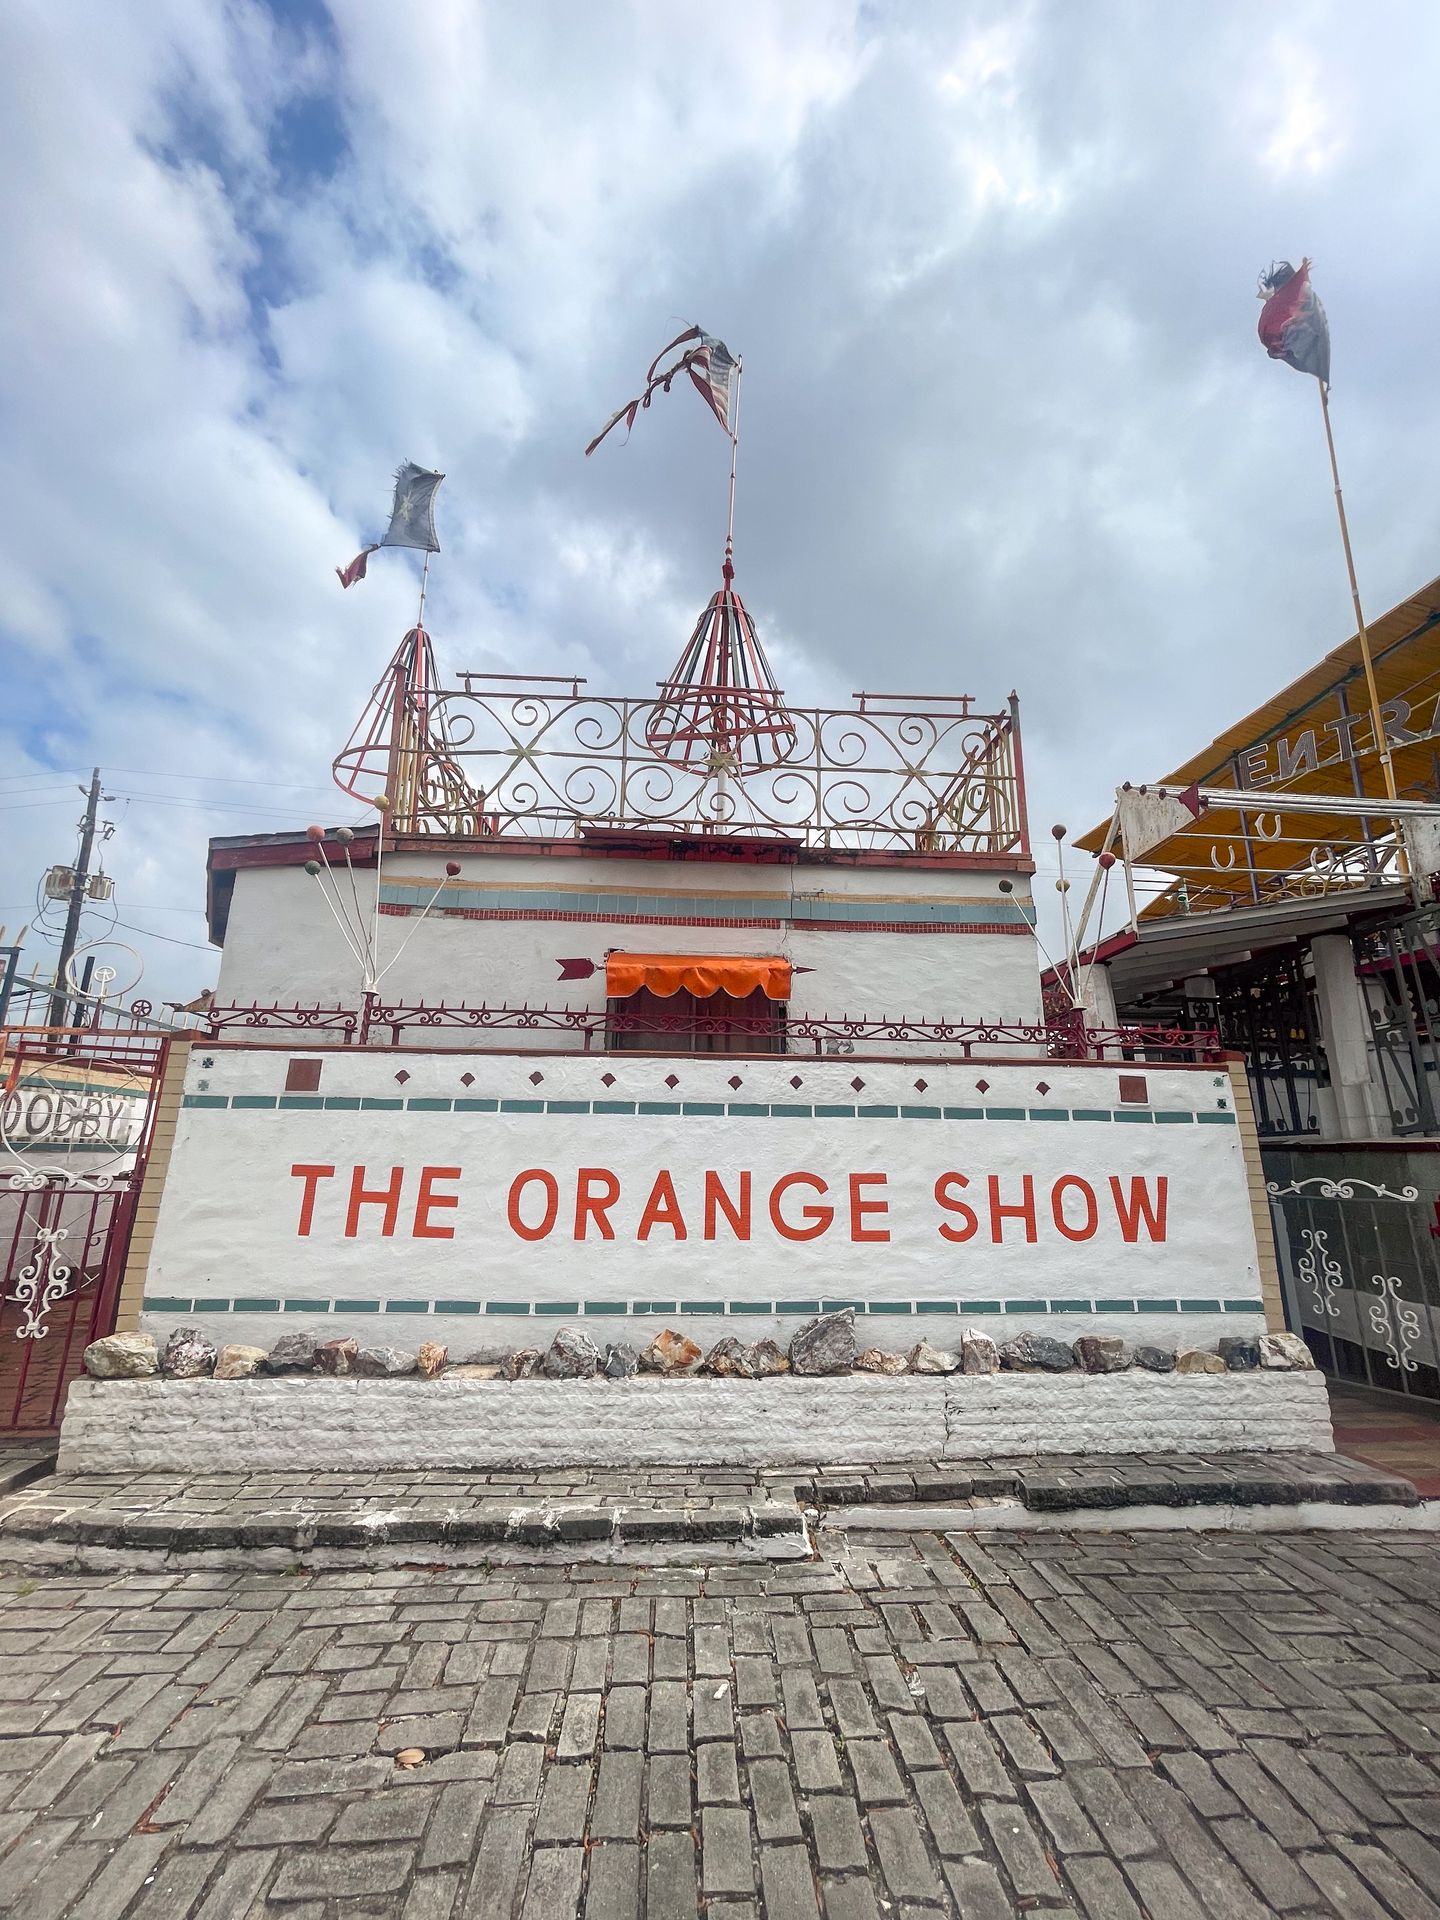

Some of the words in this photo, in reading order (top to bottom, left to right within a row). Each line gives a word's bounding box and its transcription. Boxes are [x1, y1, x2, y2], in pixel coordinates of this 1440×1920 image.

[1239, 693, 1440, 791] ENTR
[291, 1165, 460, 1239] THE
[508, 1168, 890, 1241] ORANGE
[934, 1172, 1168, 1243] SHOW
